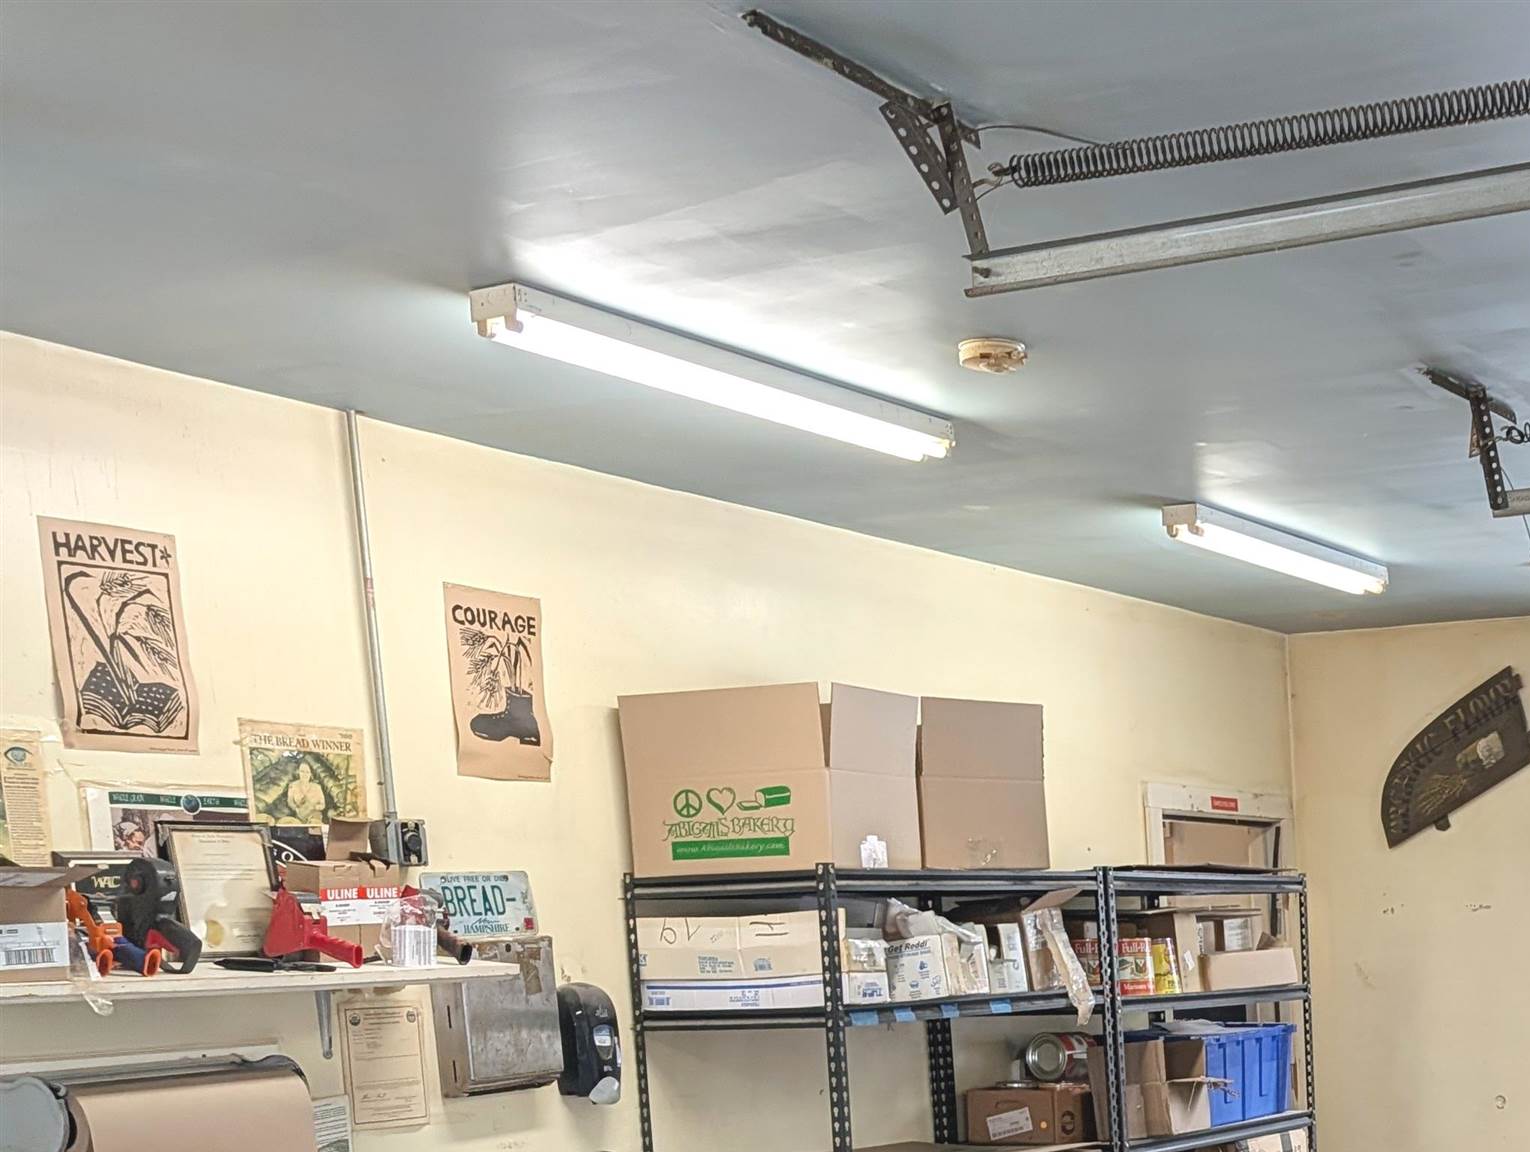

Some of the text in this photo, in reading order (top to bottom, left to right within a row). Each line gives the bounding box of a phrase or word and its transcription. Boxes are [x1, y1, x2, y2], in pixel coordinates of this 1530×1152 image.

[52, 531, 158, 568] HARVEST
[452, 604, 536, 636] COURAGE
[252, 734, 352, 753] THE BREAD WINNER
[731, 816, 796, 837] BAKERY
[327, 887, 358, 899] ULINE
[366, 887, 398, 898] ULINE
[464, 923, 510, 934] HAMPSHIRE
